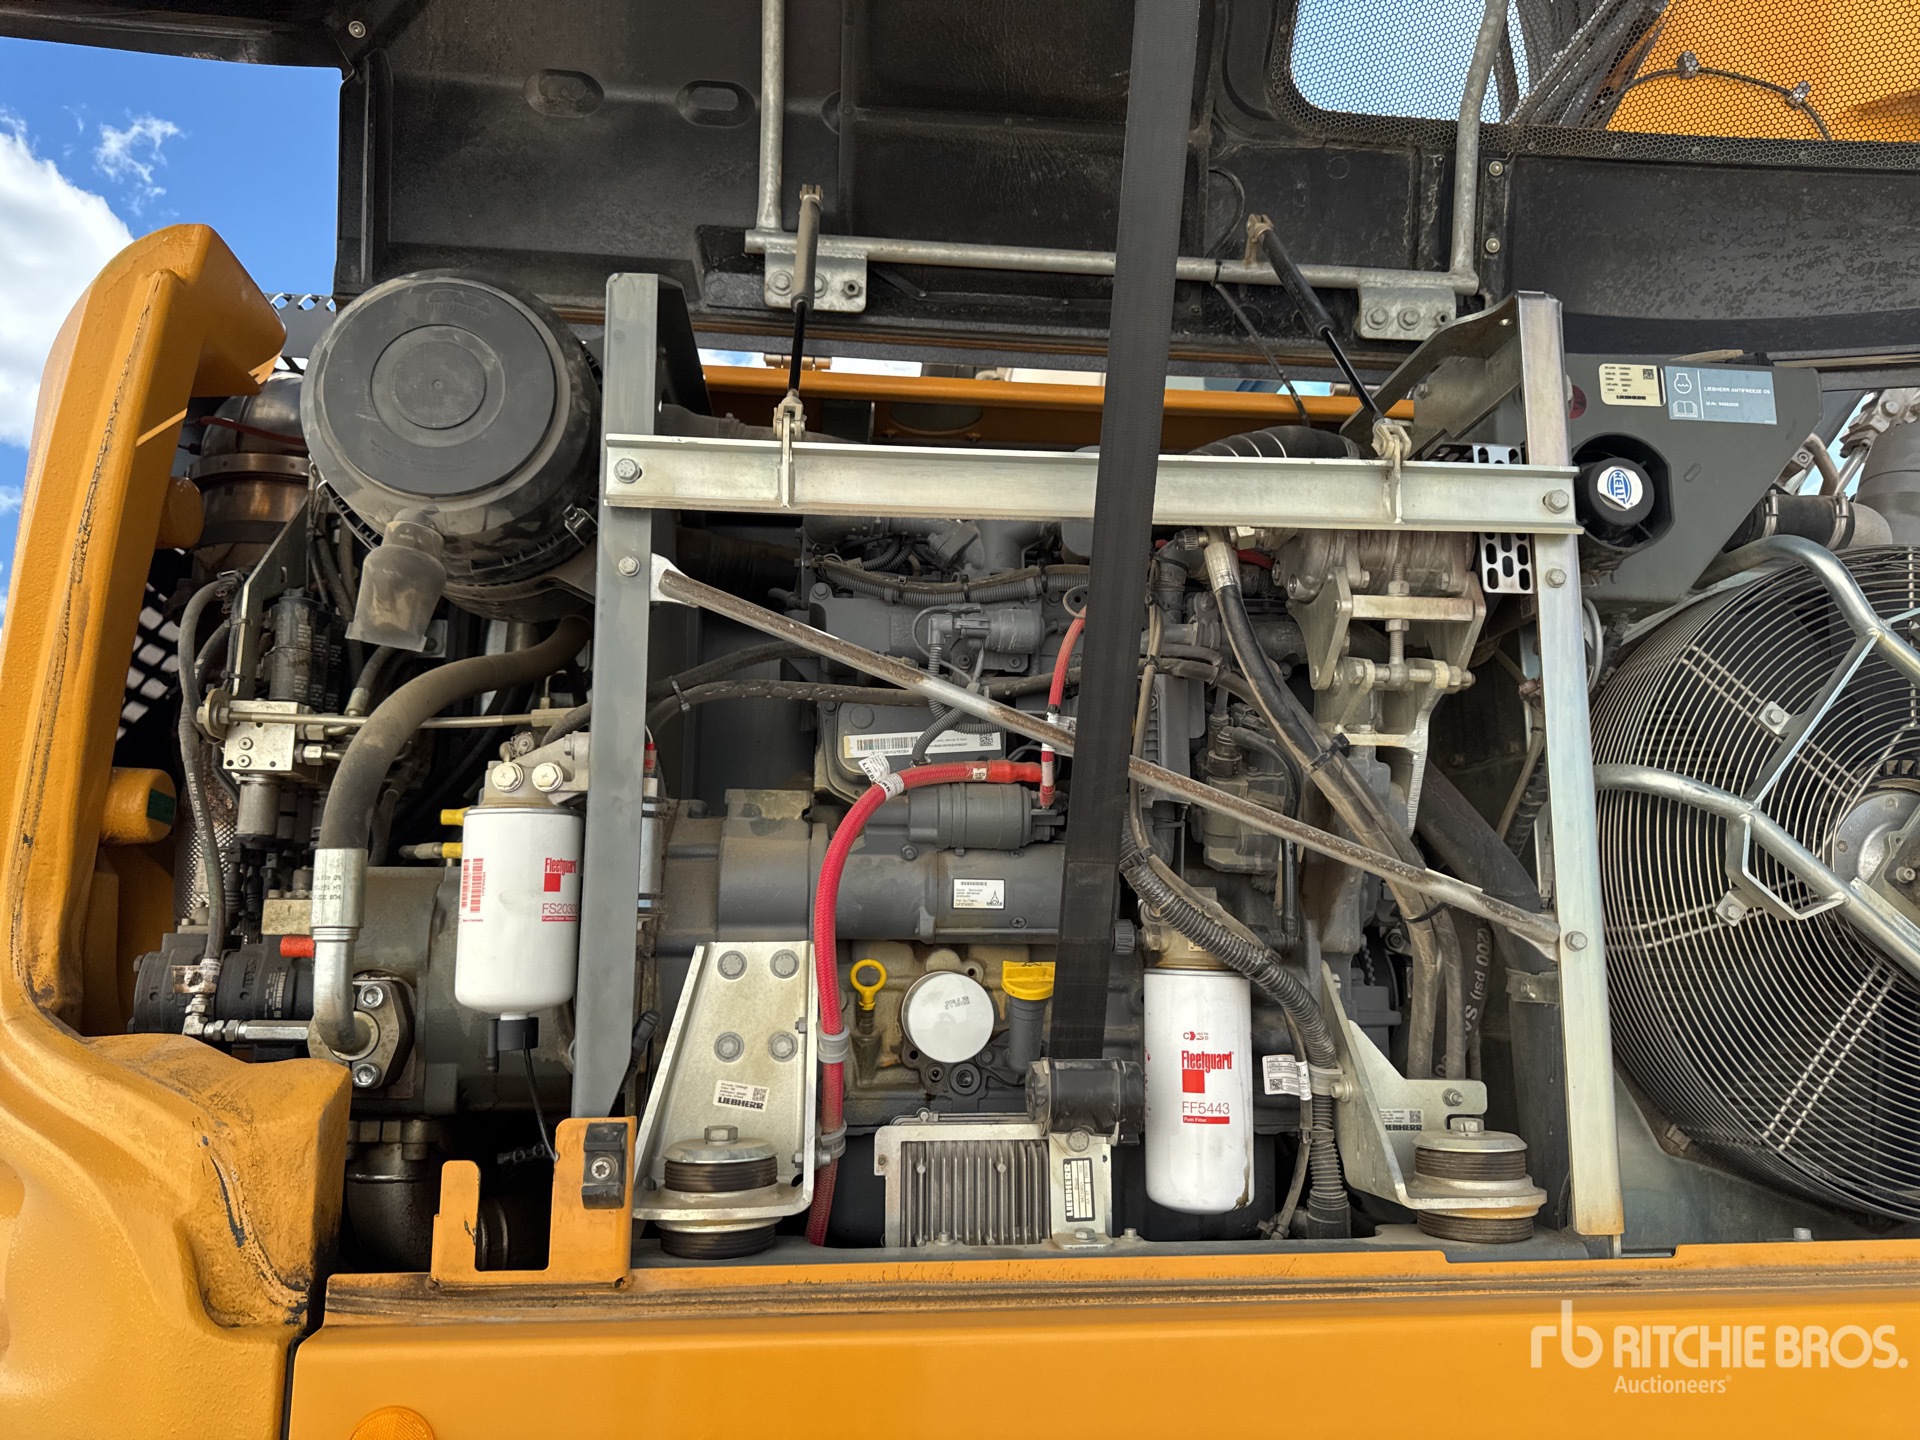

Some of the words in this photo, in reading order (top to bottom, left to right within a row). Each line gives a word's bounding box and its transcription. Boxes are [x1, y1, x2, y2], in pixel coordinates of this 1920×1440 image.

[188, 772, 196, 782] EN
[190, 782, 199, 795] 857
[194, 800, 202, 811] DN
[1469, 970, 1486, 1000] psi)
[1181, 1050, 1232, 1073] Fleetguard
[717, 1096, 764, 1110] LIEBHERR
[1182, 1101, 1230, 1115] FF5443
[1064, 1163, 1074, 1217] LIEBHERR
